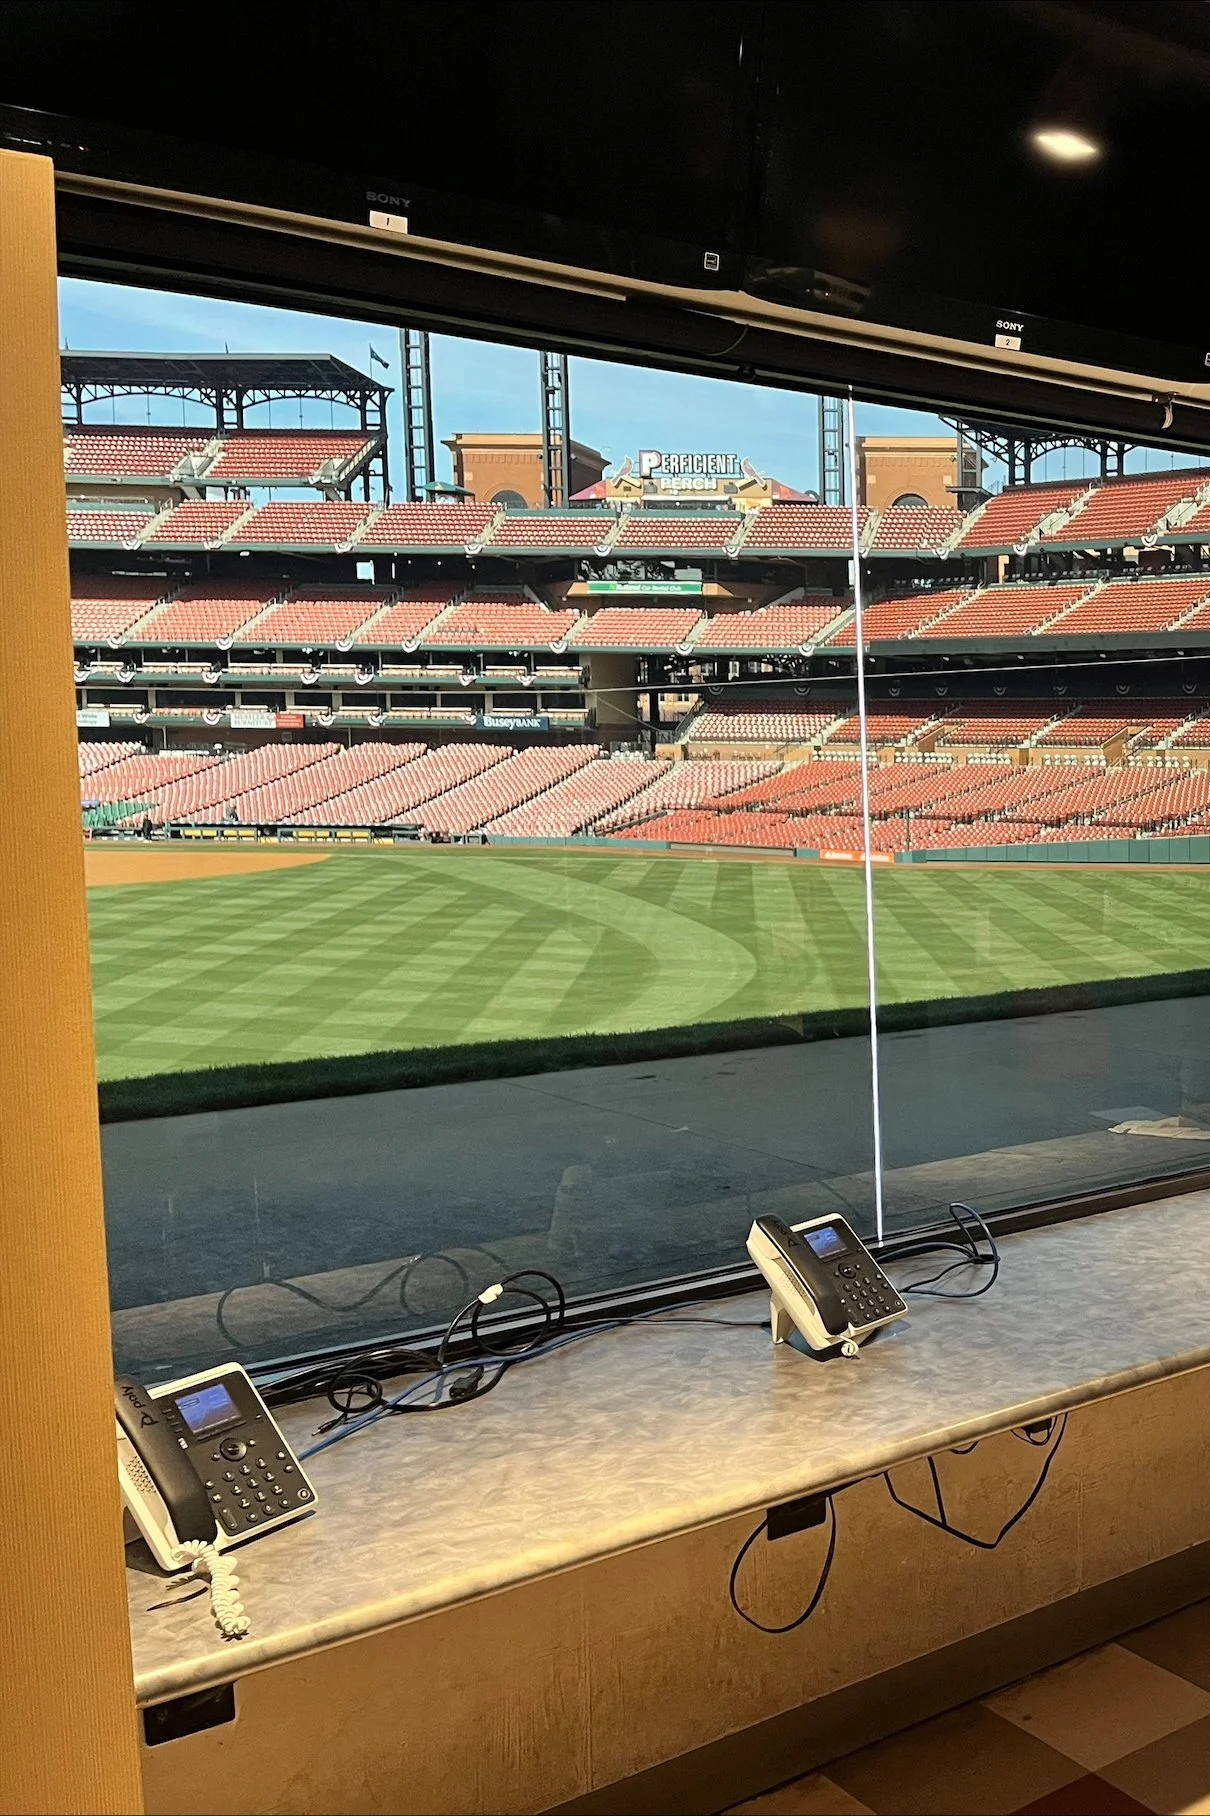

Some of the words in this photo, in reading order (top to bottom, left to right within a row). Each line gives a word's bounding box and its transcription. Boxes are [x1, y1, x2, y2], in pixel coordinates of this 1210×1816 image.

[366, 191, 411, 208] SONY
[995, 319, 1024, 332] SONY
[639, 449, 737, 479] PERFICIENT
[660, 477, 717, 491] PERCH
[120, 1385, 147, 1409] poly
